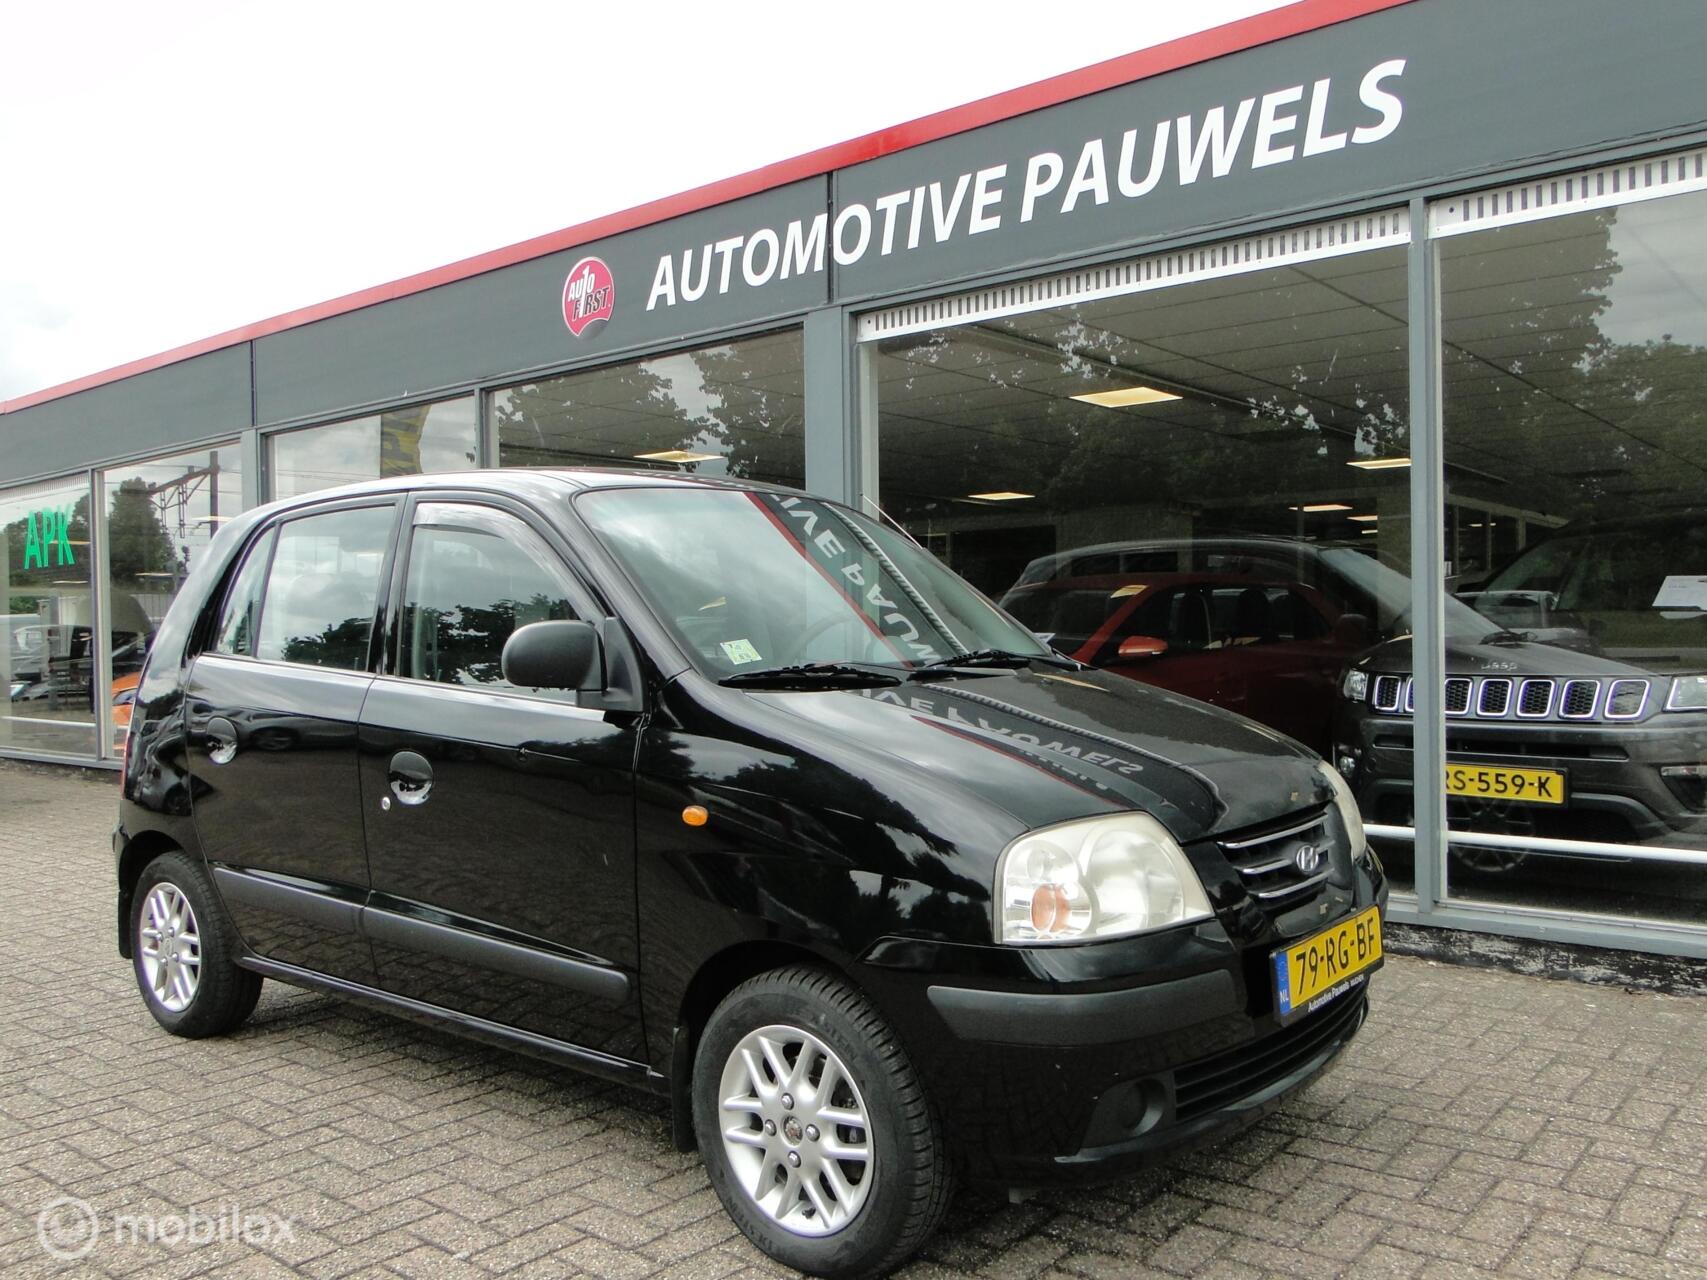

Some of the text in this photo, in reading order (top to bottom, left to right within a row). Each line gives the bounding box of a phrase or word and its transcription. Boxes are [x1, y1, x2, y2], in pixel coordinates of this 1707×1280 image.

[646, 59, 1407, 312] AUTOMOTIVE PAUWELS
[24, 504, 75, 570] APK
[1296, 917, 1375, 996] 79-RG-BF
[1280, 989, 1289, 1004] NL
